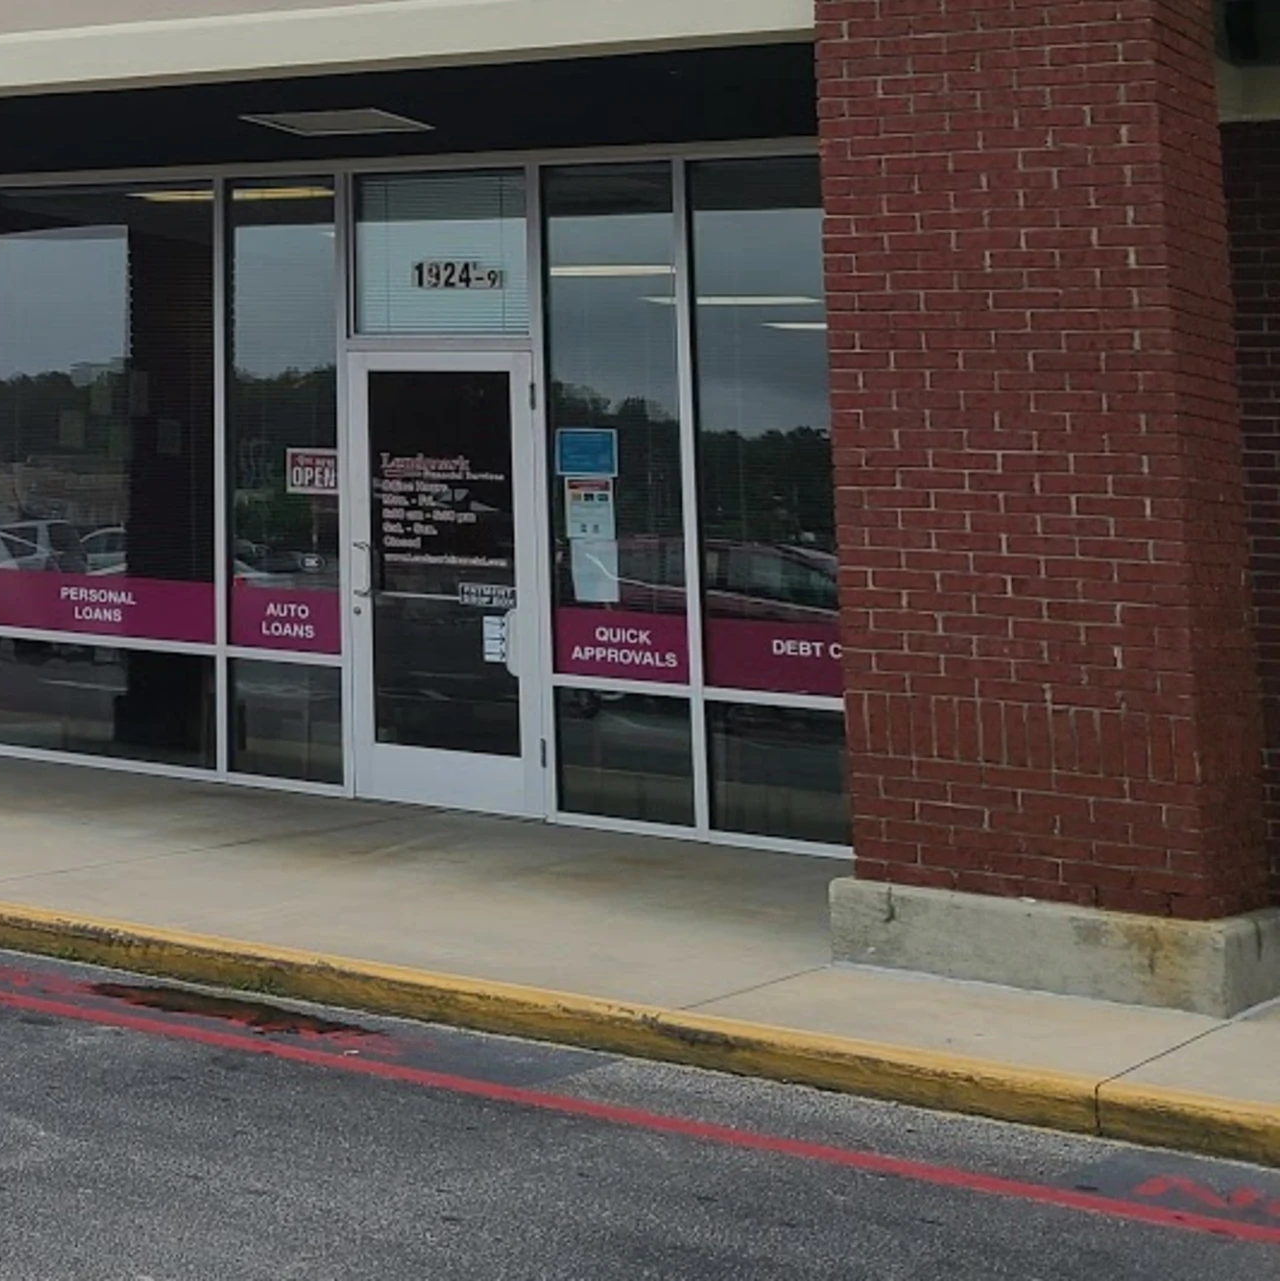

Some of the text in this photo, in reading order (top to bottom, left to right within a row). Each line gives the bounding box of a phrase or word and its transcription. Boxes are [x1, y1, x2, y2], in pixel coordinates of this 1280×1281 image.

[292, 467, 335, 487] OPEN
[60, 587, 136, 605] PERSONAL
[74, 606, 122, 622] LOANS
[266, 604, 309, 619] AUTO
[261, 622, 315, 639] LOANS
[595, 627, 652, 645] QUICK
[571, 646, 678, 668] APPROVALS
[772, 639, 823, 658] DEBT
